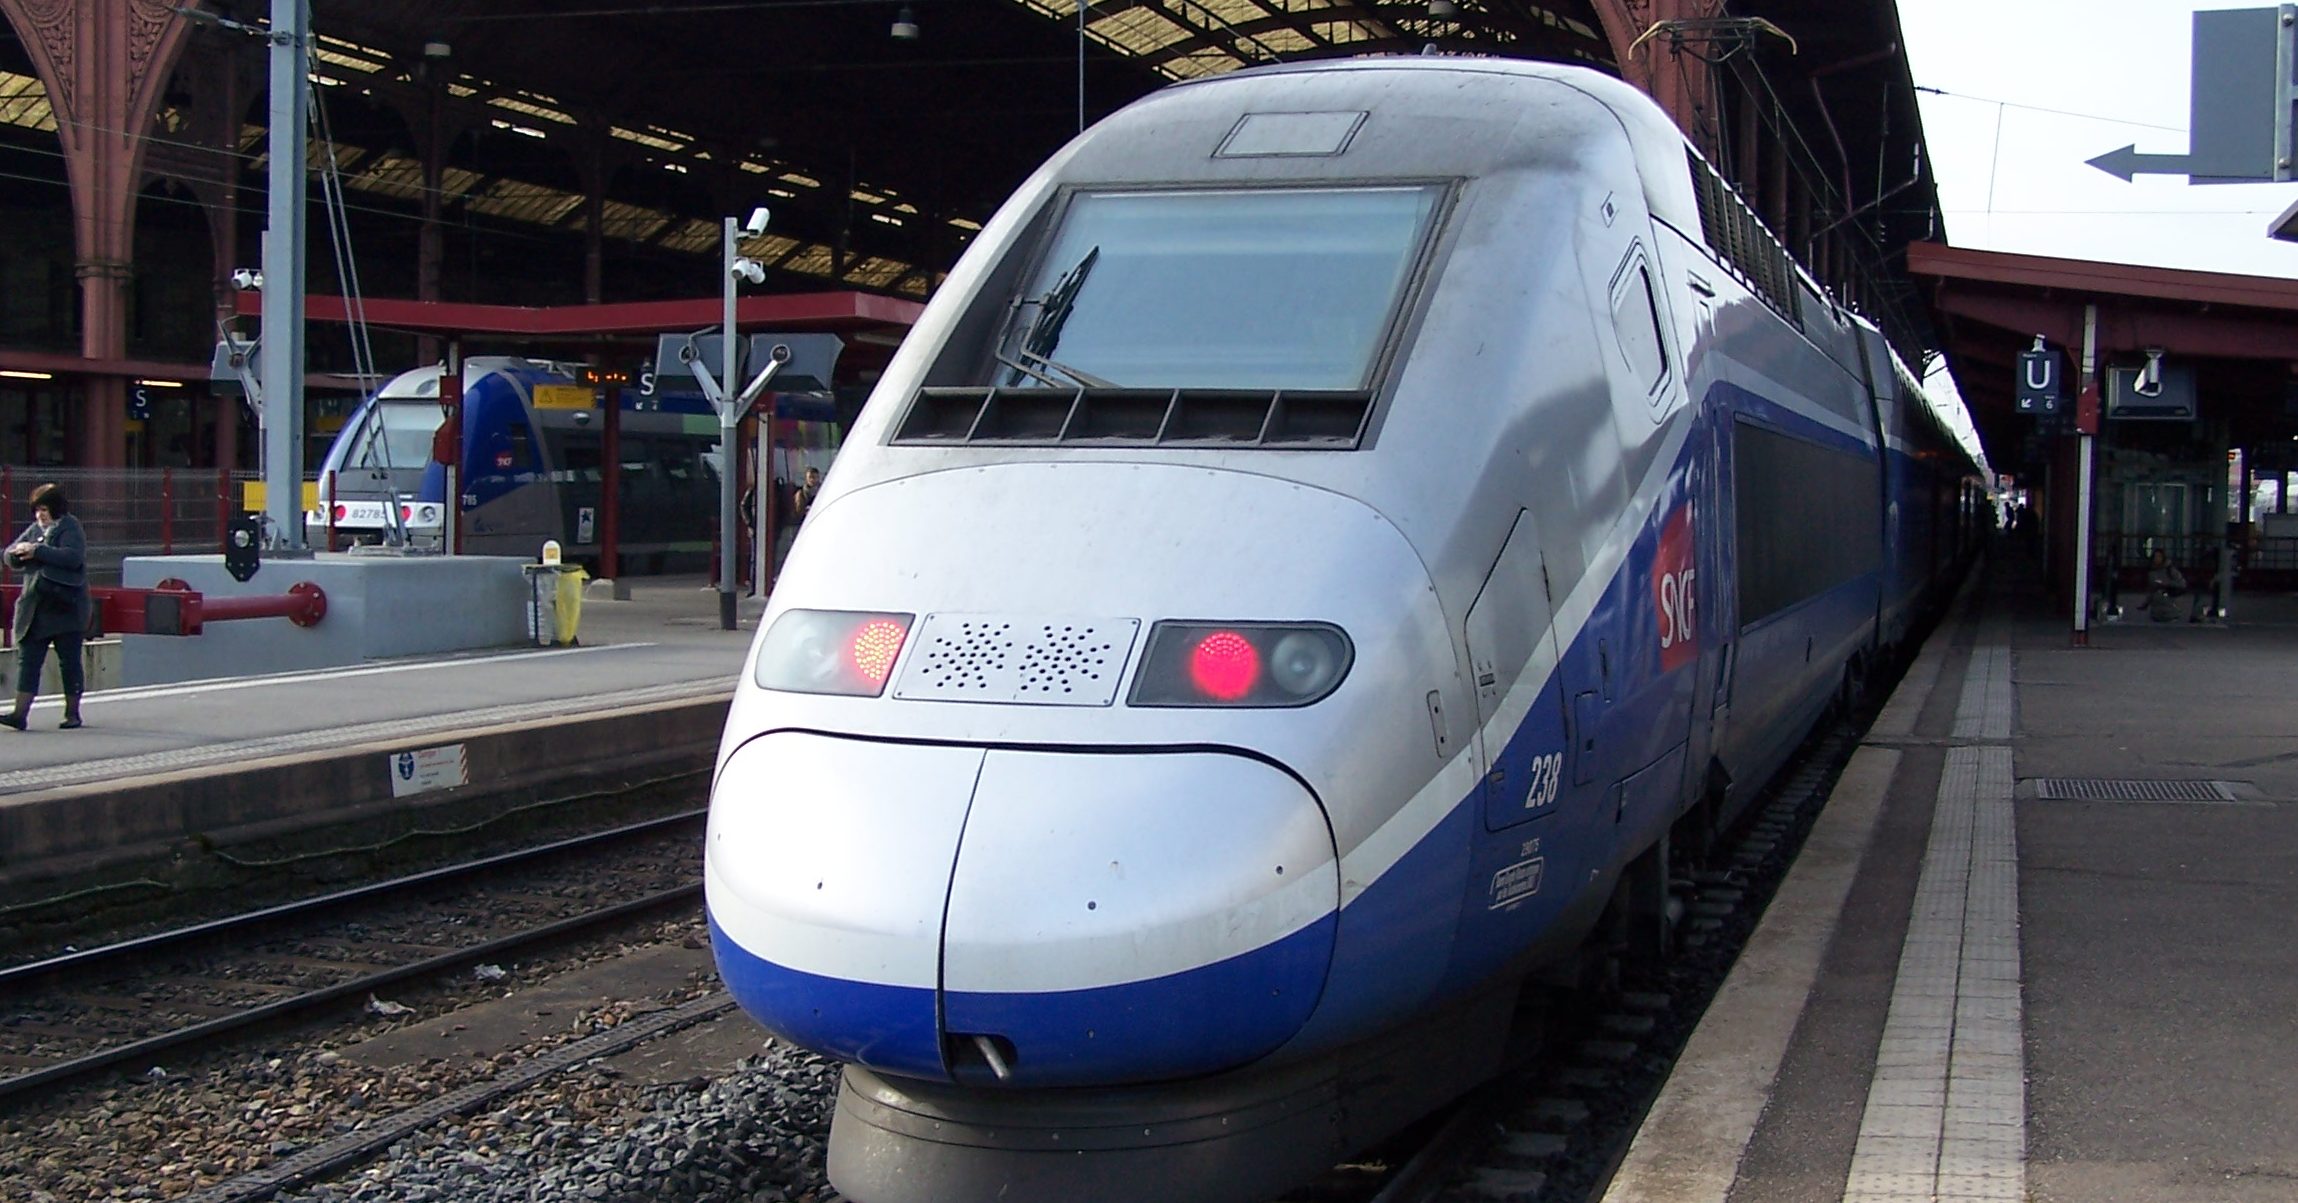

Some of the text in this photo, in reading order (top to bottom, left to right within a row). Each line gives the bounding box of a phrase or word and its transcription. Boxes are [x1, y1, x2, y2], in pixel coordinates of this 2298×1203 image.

[641, 373, 654, 395] S
[2027, 360, 2050, 389] U
[136, 390, 146, 407] S
[2046, 400, 2053, 409] 6
[1661, 568, 1695, 649] SNCF
[1525, 752, 1562, 808] 238
